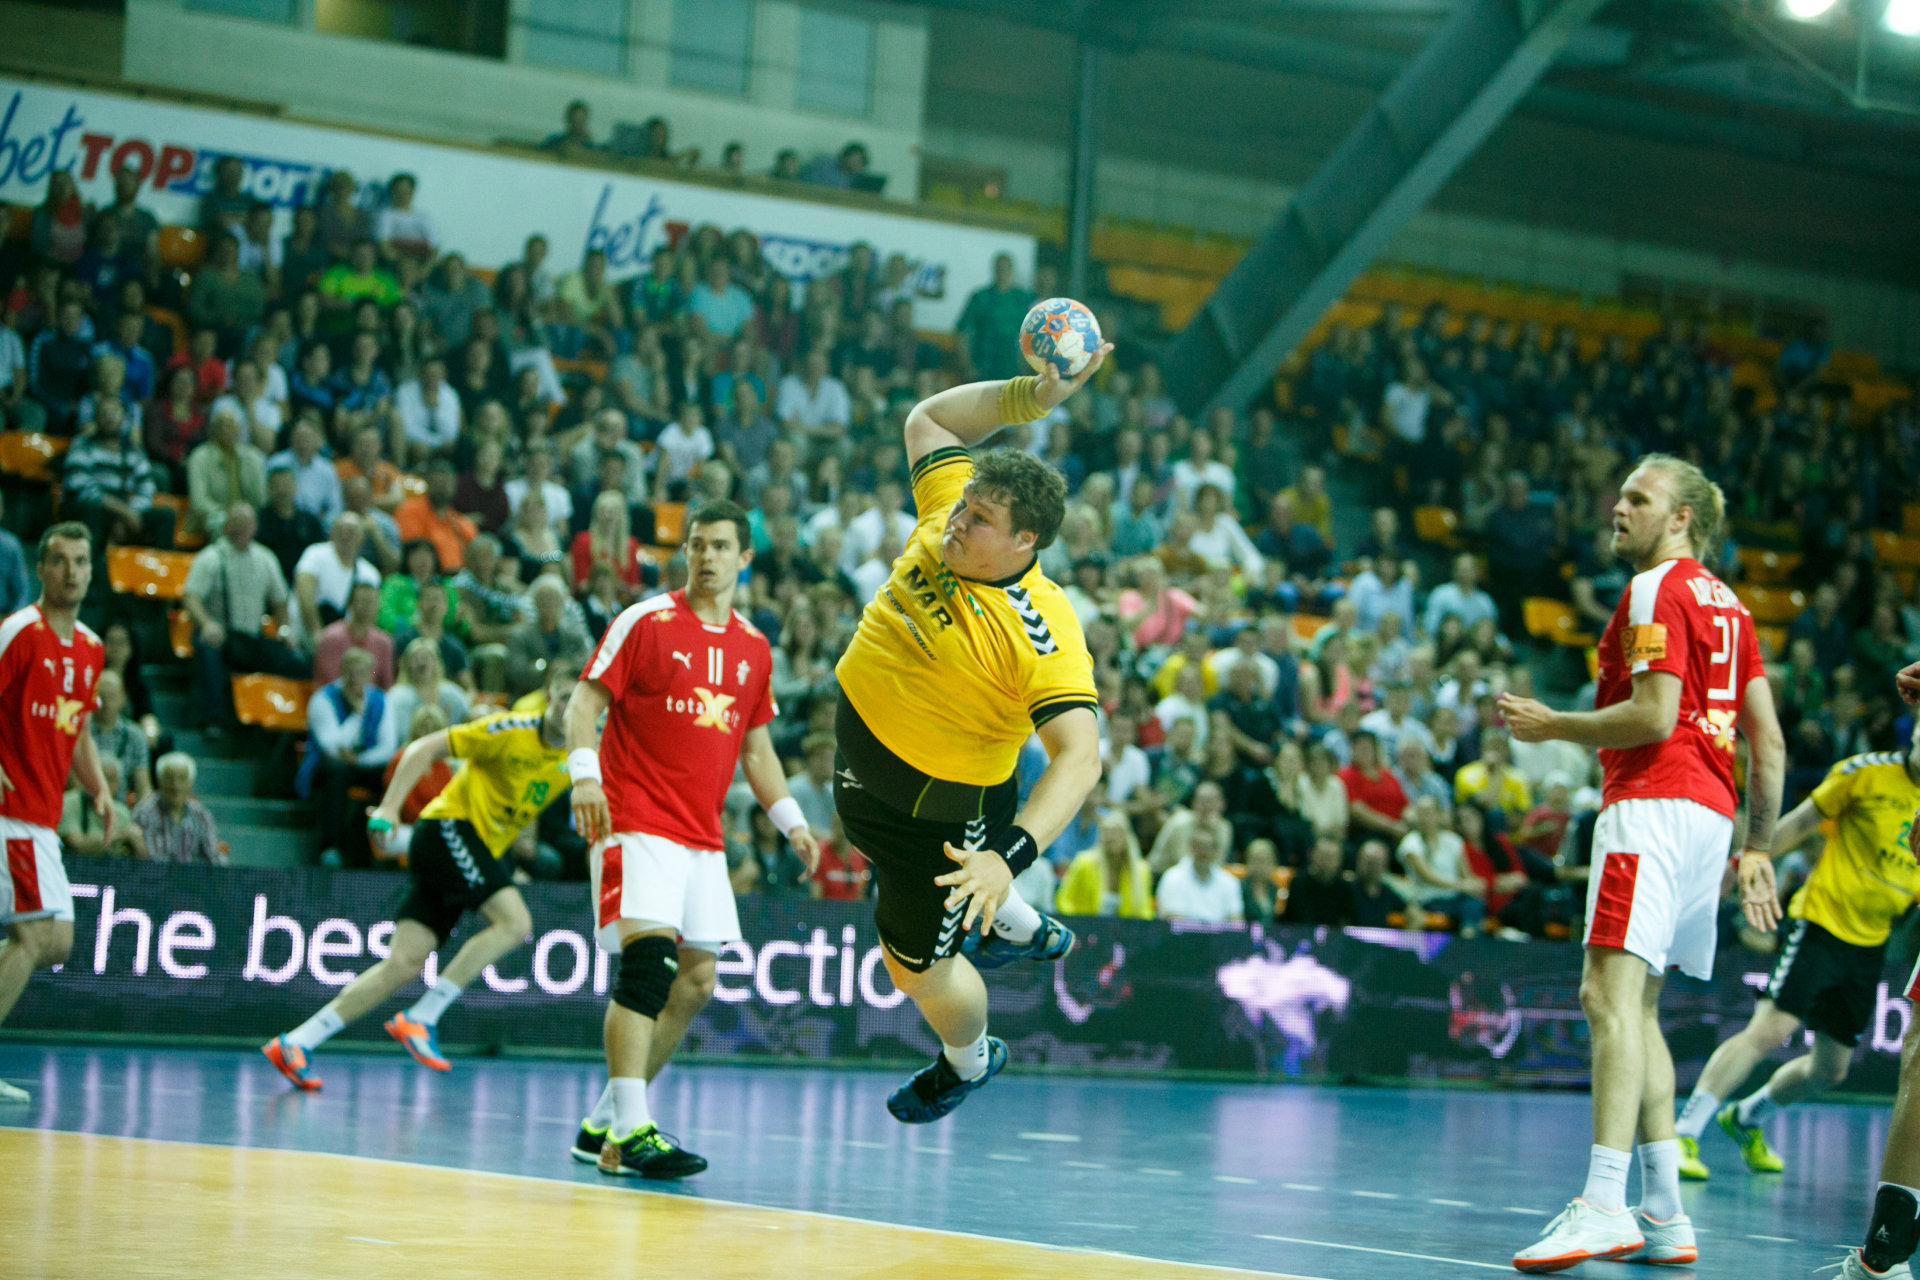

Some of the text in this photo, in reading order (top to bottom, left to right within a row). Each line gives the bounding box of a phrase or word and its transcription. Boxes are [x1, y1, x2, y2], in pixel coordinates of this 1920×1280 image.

[0, 91, 83, 186] bet
[583, 184, 662, 266] bet
[707, 646, 723, 686] 11
[242, 892, 439, 989] bes
